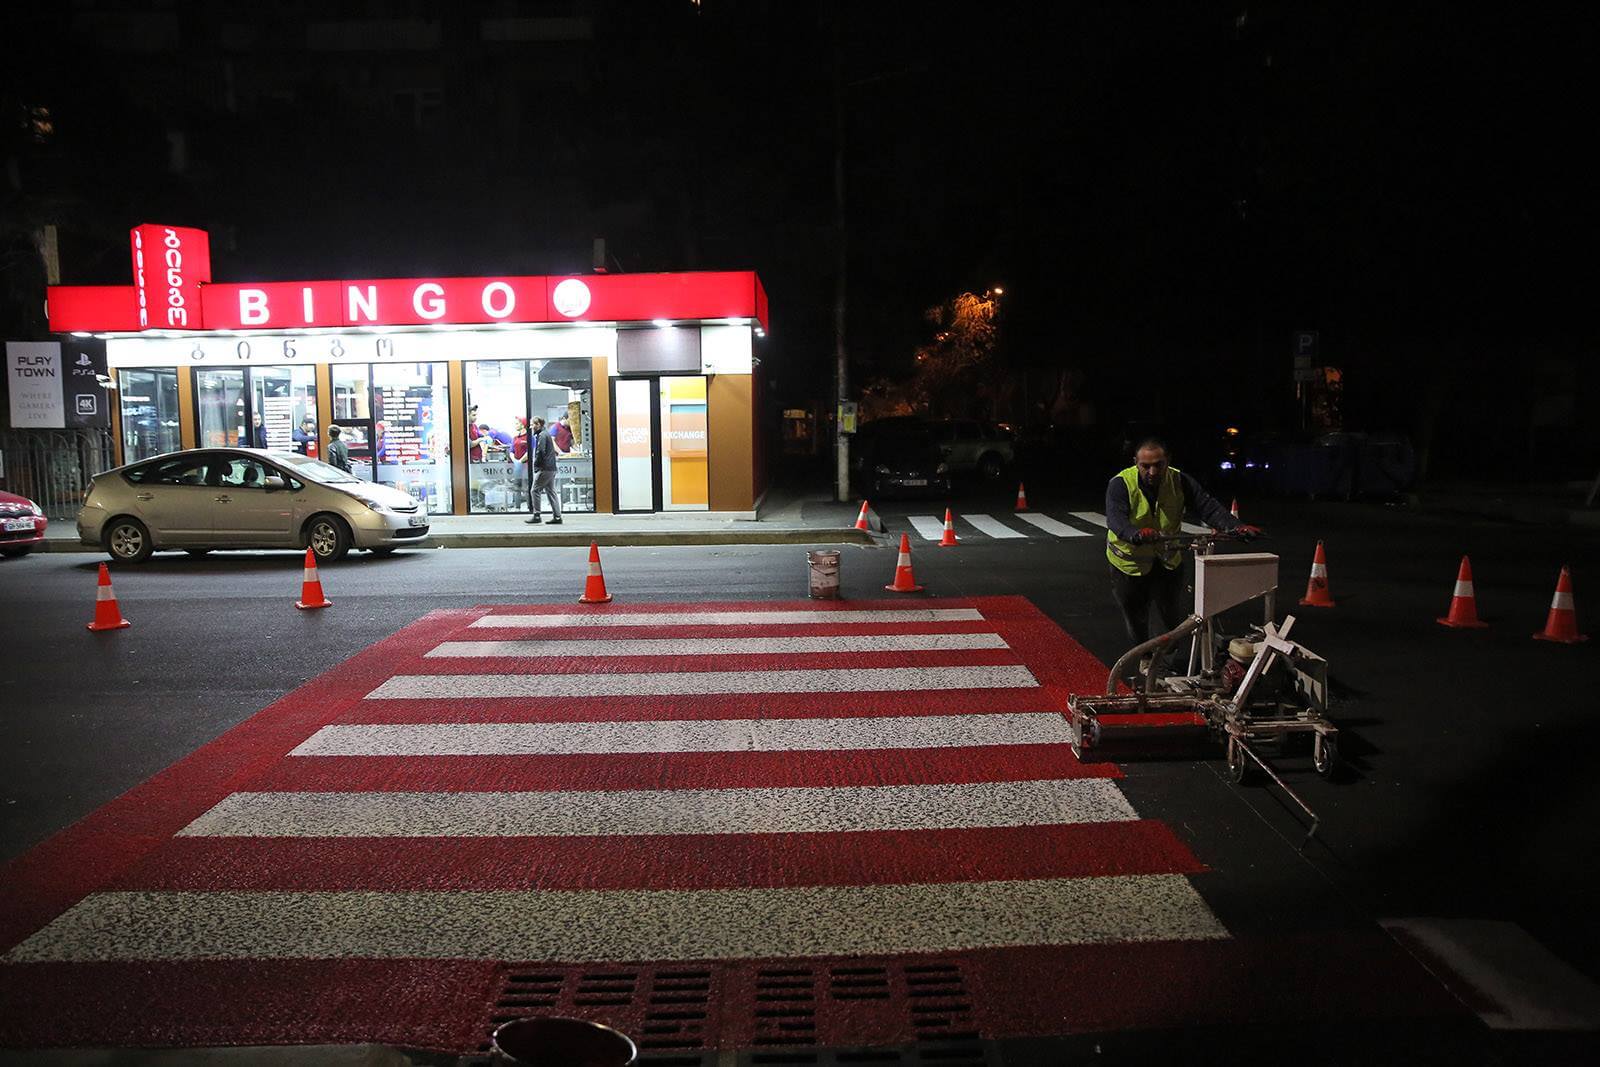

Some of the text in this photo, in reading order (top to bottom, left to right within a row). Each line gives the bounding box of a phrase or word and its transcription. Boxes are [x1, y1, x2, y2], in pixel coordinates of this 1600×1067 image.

[164, 228, 188, 326] ბინგო
[239, 281, 516, 326] BINGO
[1299, 334, 1313, 353] P
[190, 337, 394, 361] ბინგო
[17, 356, 52, 366] PLAY
[14, 368, 55, 377] TOWN
[72, 368, 96, 376] PS4
[21, 392, 52, 400] WHERE
[79, 399, 93, 408] 4K
[663, 430, 705, 439] EXCHANGE
